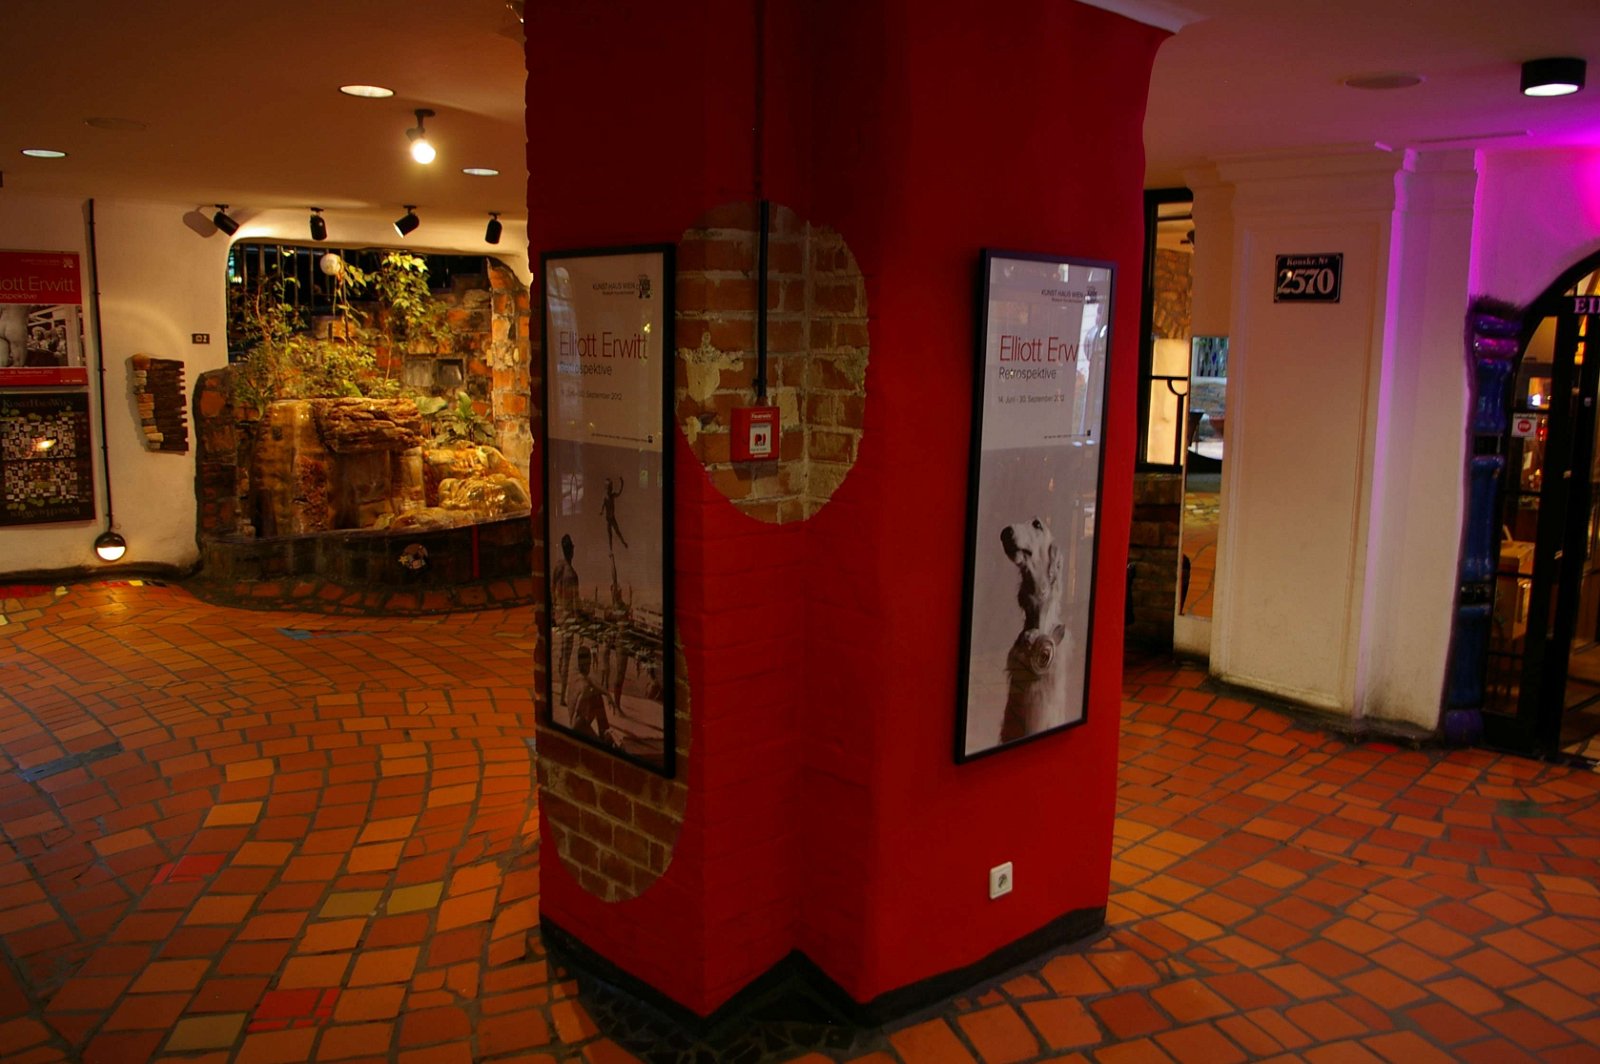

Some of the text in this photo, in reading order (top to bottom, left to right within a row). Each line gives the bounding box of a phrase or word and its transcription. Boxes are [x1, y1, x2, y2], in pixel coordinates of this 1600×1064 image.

[28, 275, 75, 292] Erwitt
[1277, 268, 1335, 294] 2570
[559, 331, 648, 360] Elliott Erwitt
[1000, 335, 1042, 362] Elliott
[998, 366, 1057, 381] Retrospektive
